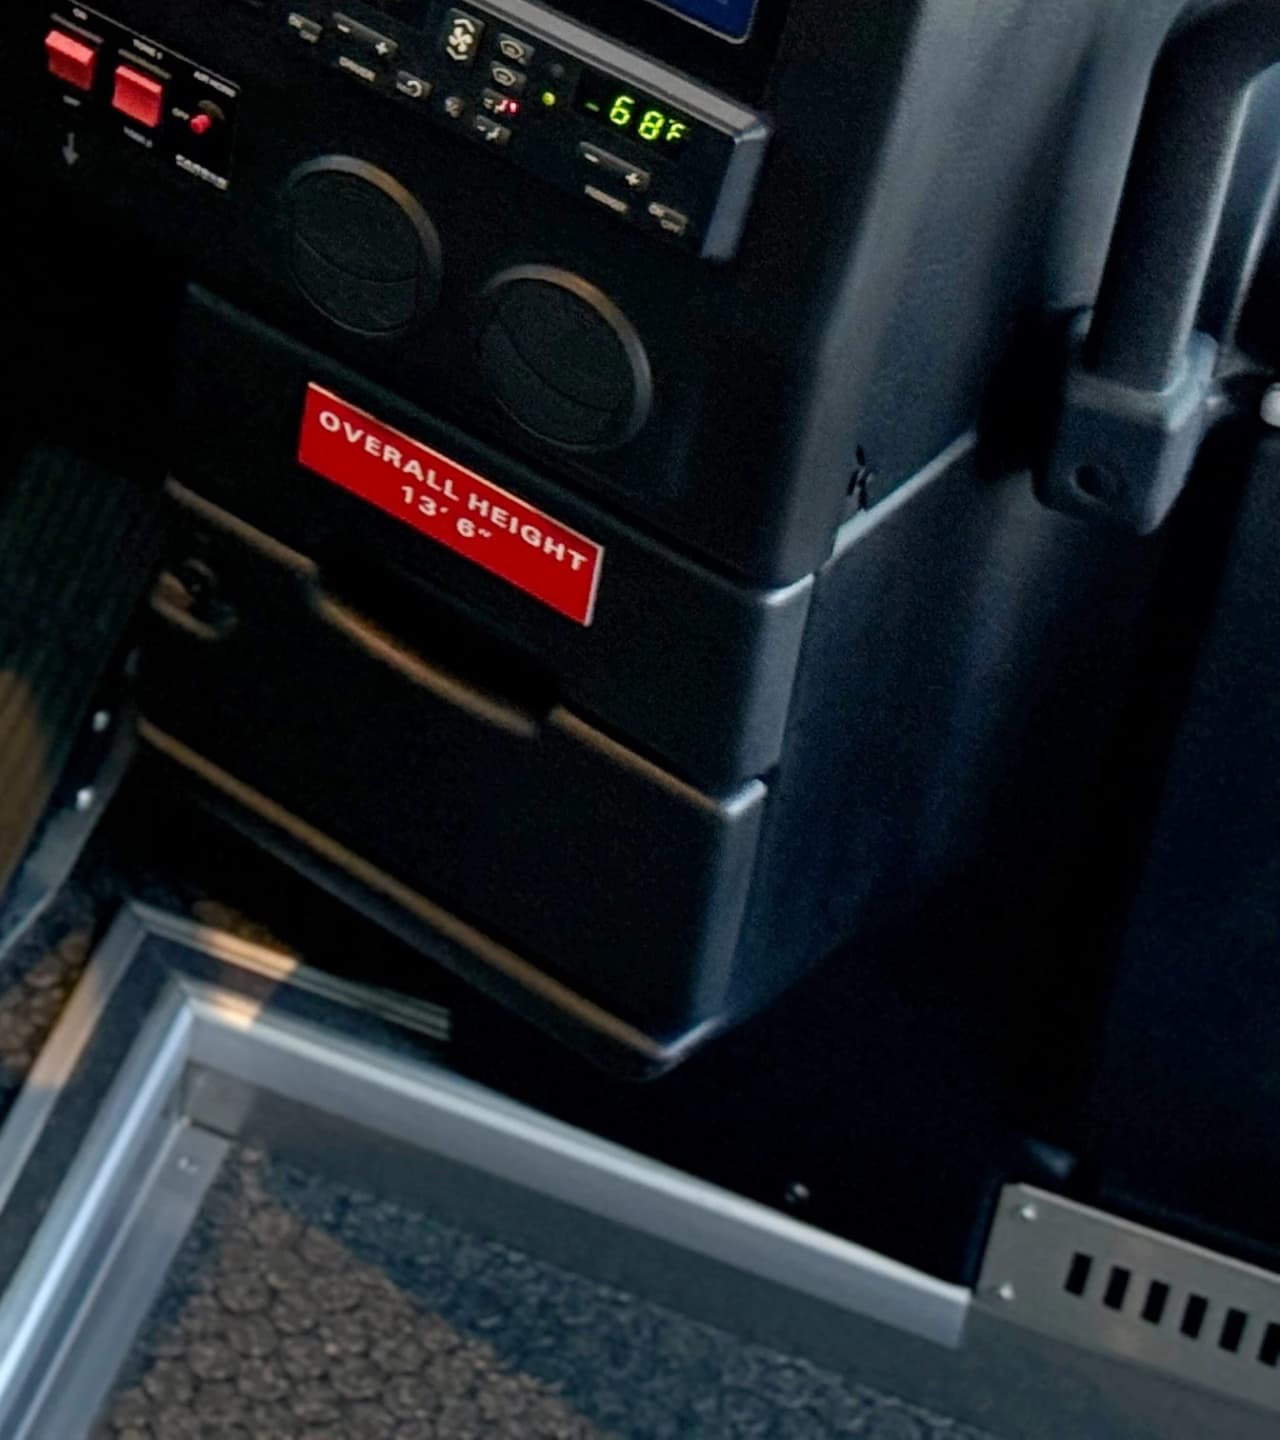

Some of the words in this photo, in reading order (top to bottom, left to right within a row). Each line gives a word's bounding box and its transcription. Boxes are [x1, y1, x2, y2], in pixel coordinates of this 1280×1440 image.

[318, 409, 460, 502] OVERALL
[468, 492, 589, 572] HEIGHT
[400, 484, 449, 517] 13'
